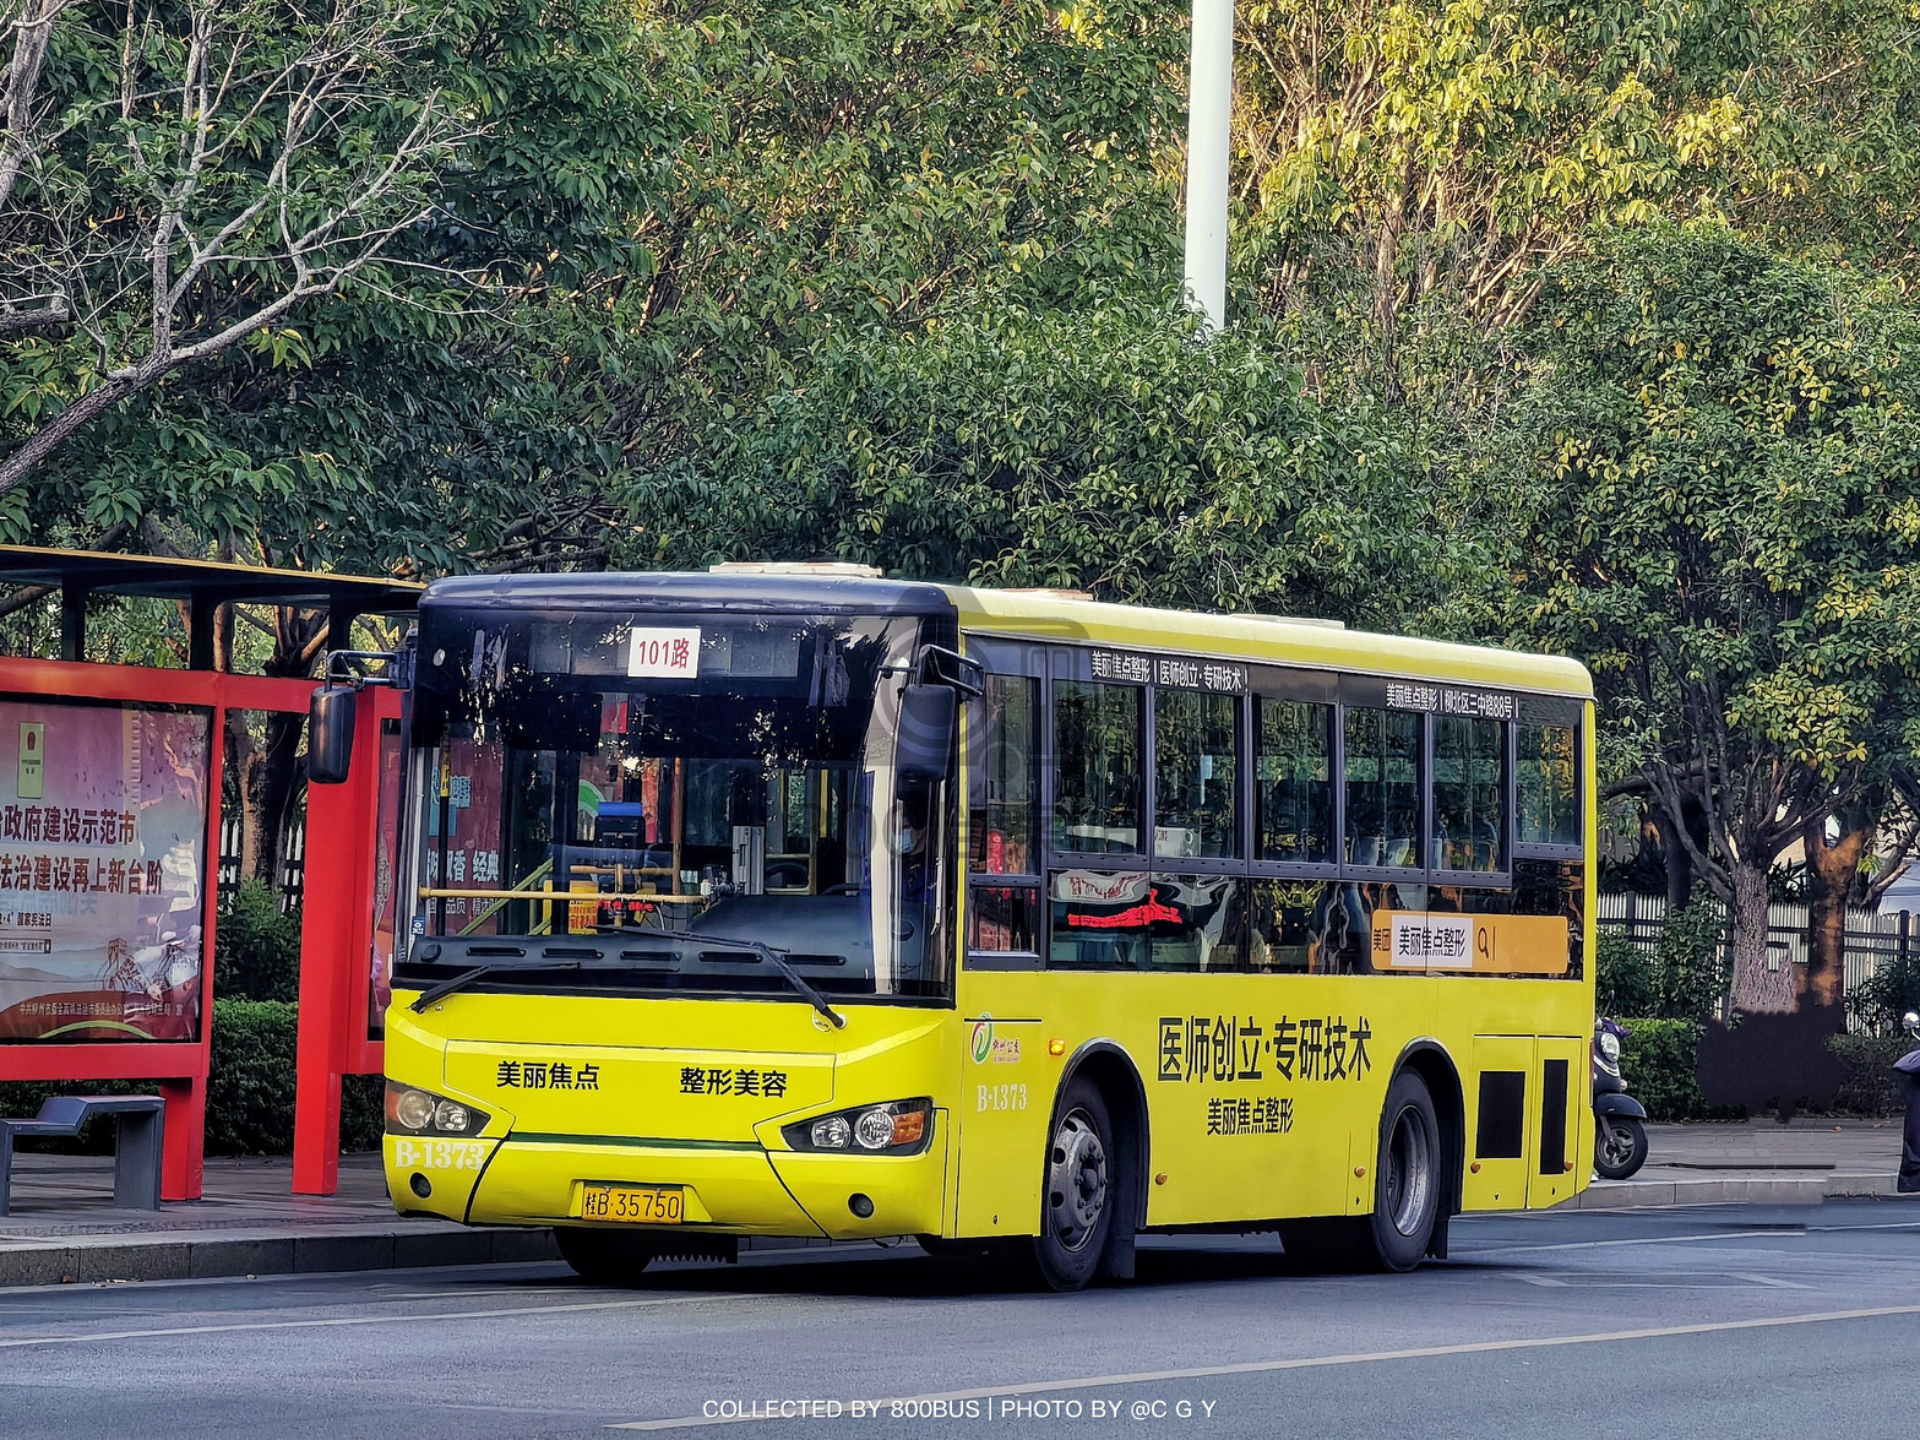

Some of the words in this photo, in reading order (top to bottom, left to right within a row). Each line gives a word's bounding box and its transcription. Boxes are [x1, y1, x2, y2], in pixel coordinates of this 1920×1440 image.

[639, 637, 690, 669] 101路
[1091, 650, 1150, 683] 美丽焦点整形
[1386, 682, 1437, 712] 美丽焦点整形
[0, 804, 136, 845] 政府建设示范市
[1399, 925, 1465, 958] 美丽焦点整形
[1158, 1015, 1372, 1083] 医师创立·专研技术
[497, 1061, 600, 1091] 美丽焦点
[679, 1067, 788, 1098] 整形美容
[1207, 1097, 1294, 1136] 美丽焦点整形
[395, 1140, 485, 1170] B-1373
